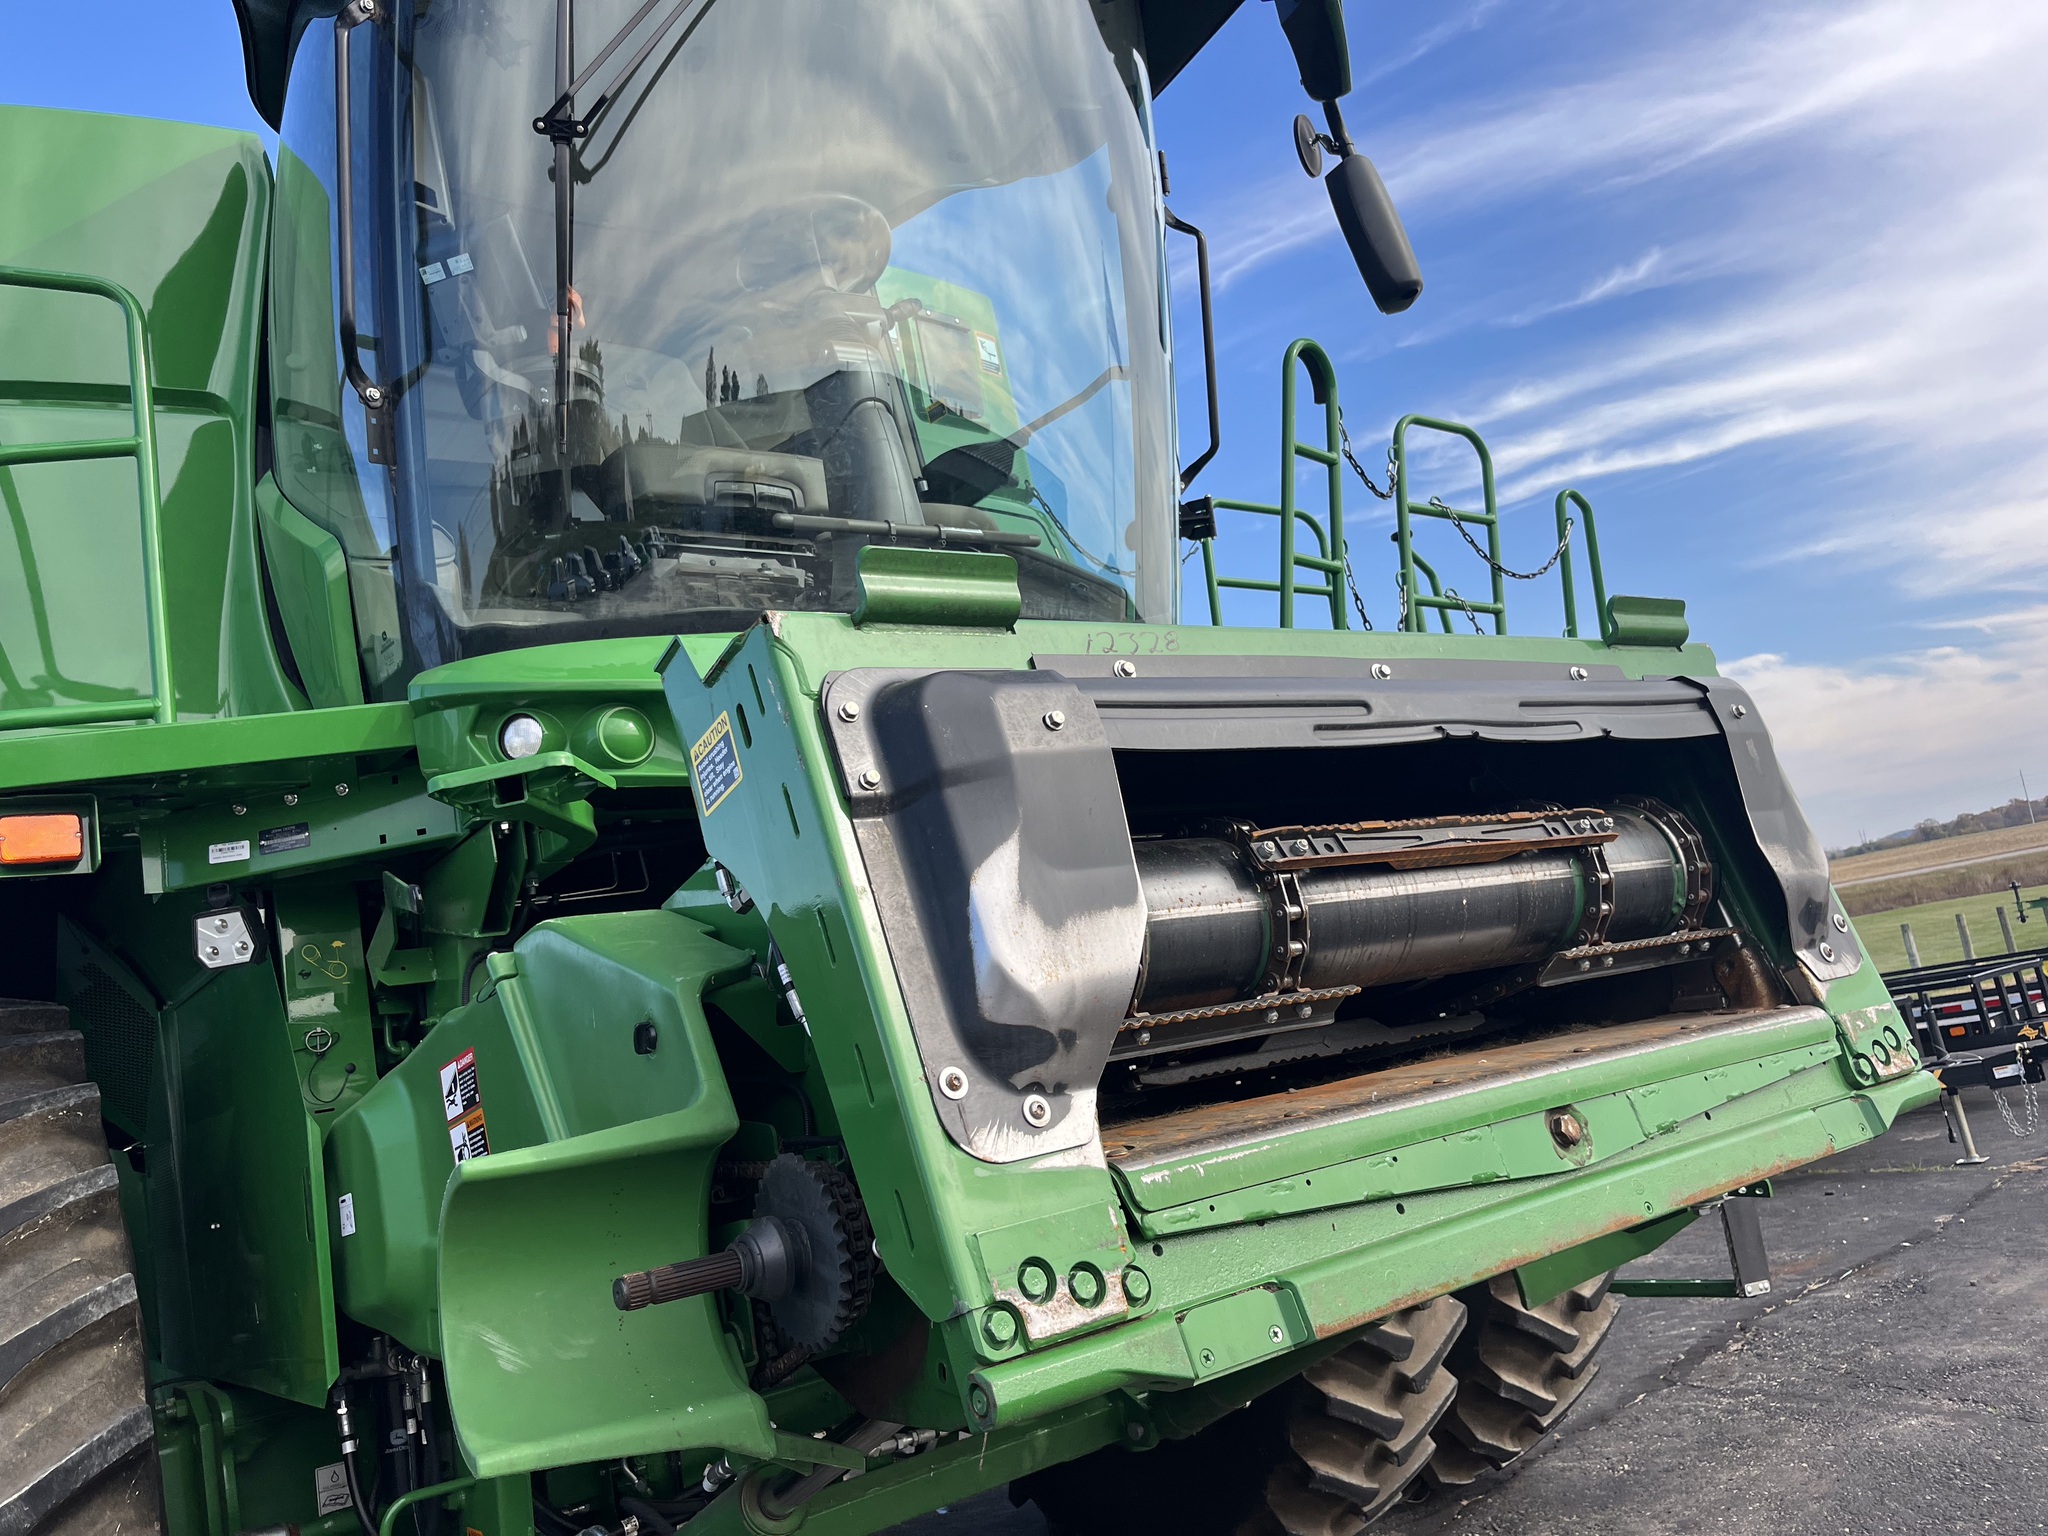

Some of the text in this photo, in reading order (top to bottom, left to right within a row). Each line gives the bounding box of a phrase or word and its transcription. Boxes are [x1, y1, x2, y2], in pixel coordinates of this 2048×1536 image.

[1085, 631, 1180, 655] 12328
[697, 716, 728, 756] CAUTION
[698, 740, 725, 773] Avoid crushing
[715, 761, 725, 774] Stay
[712, 774, 723, 788] when
[722, 760, 736, 777] engine
